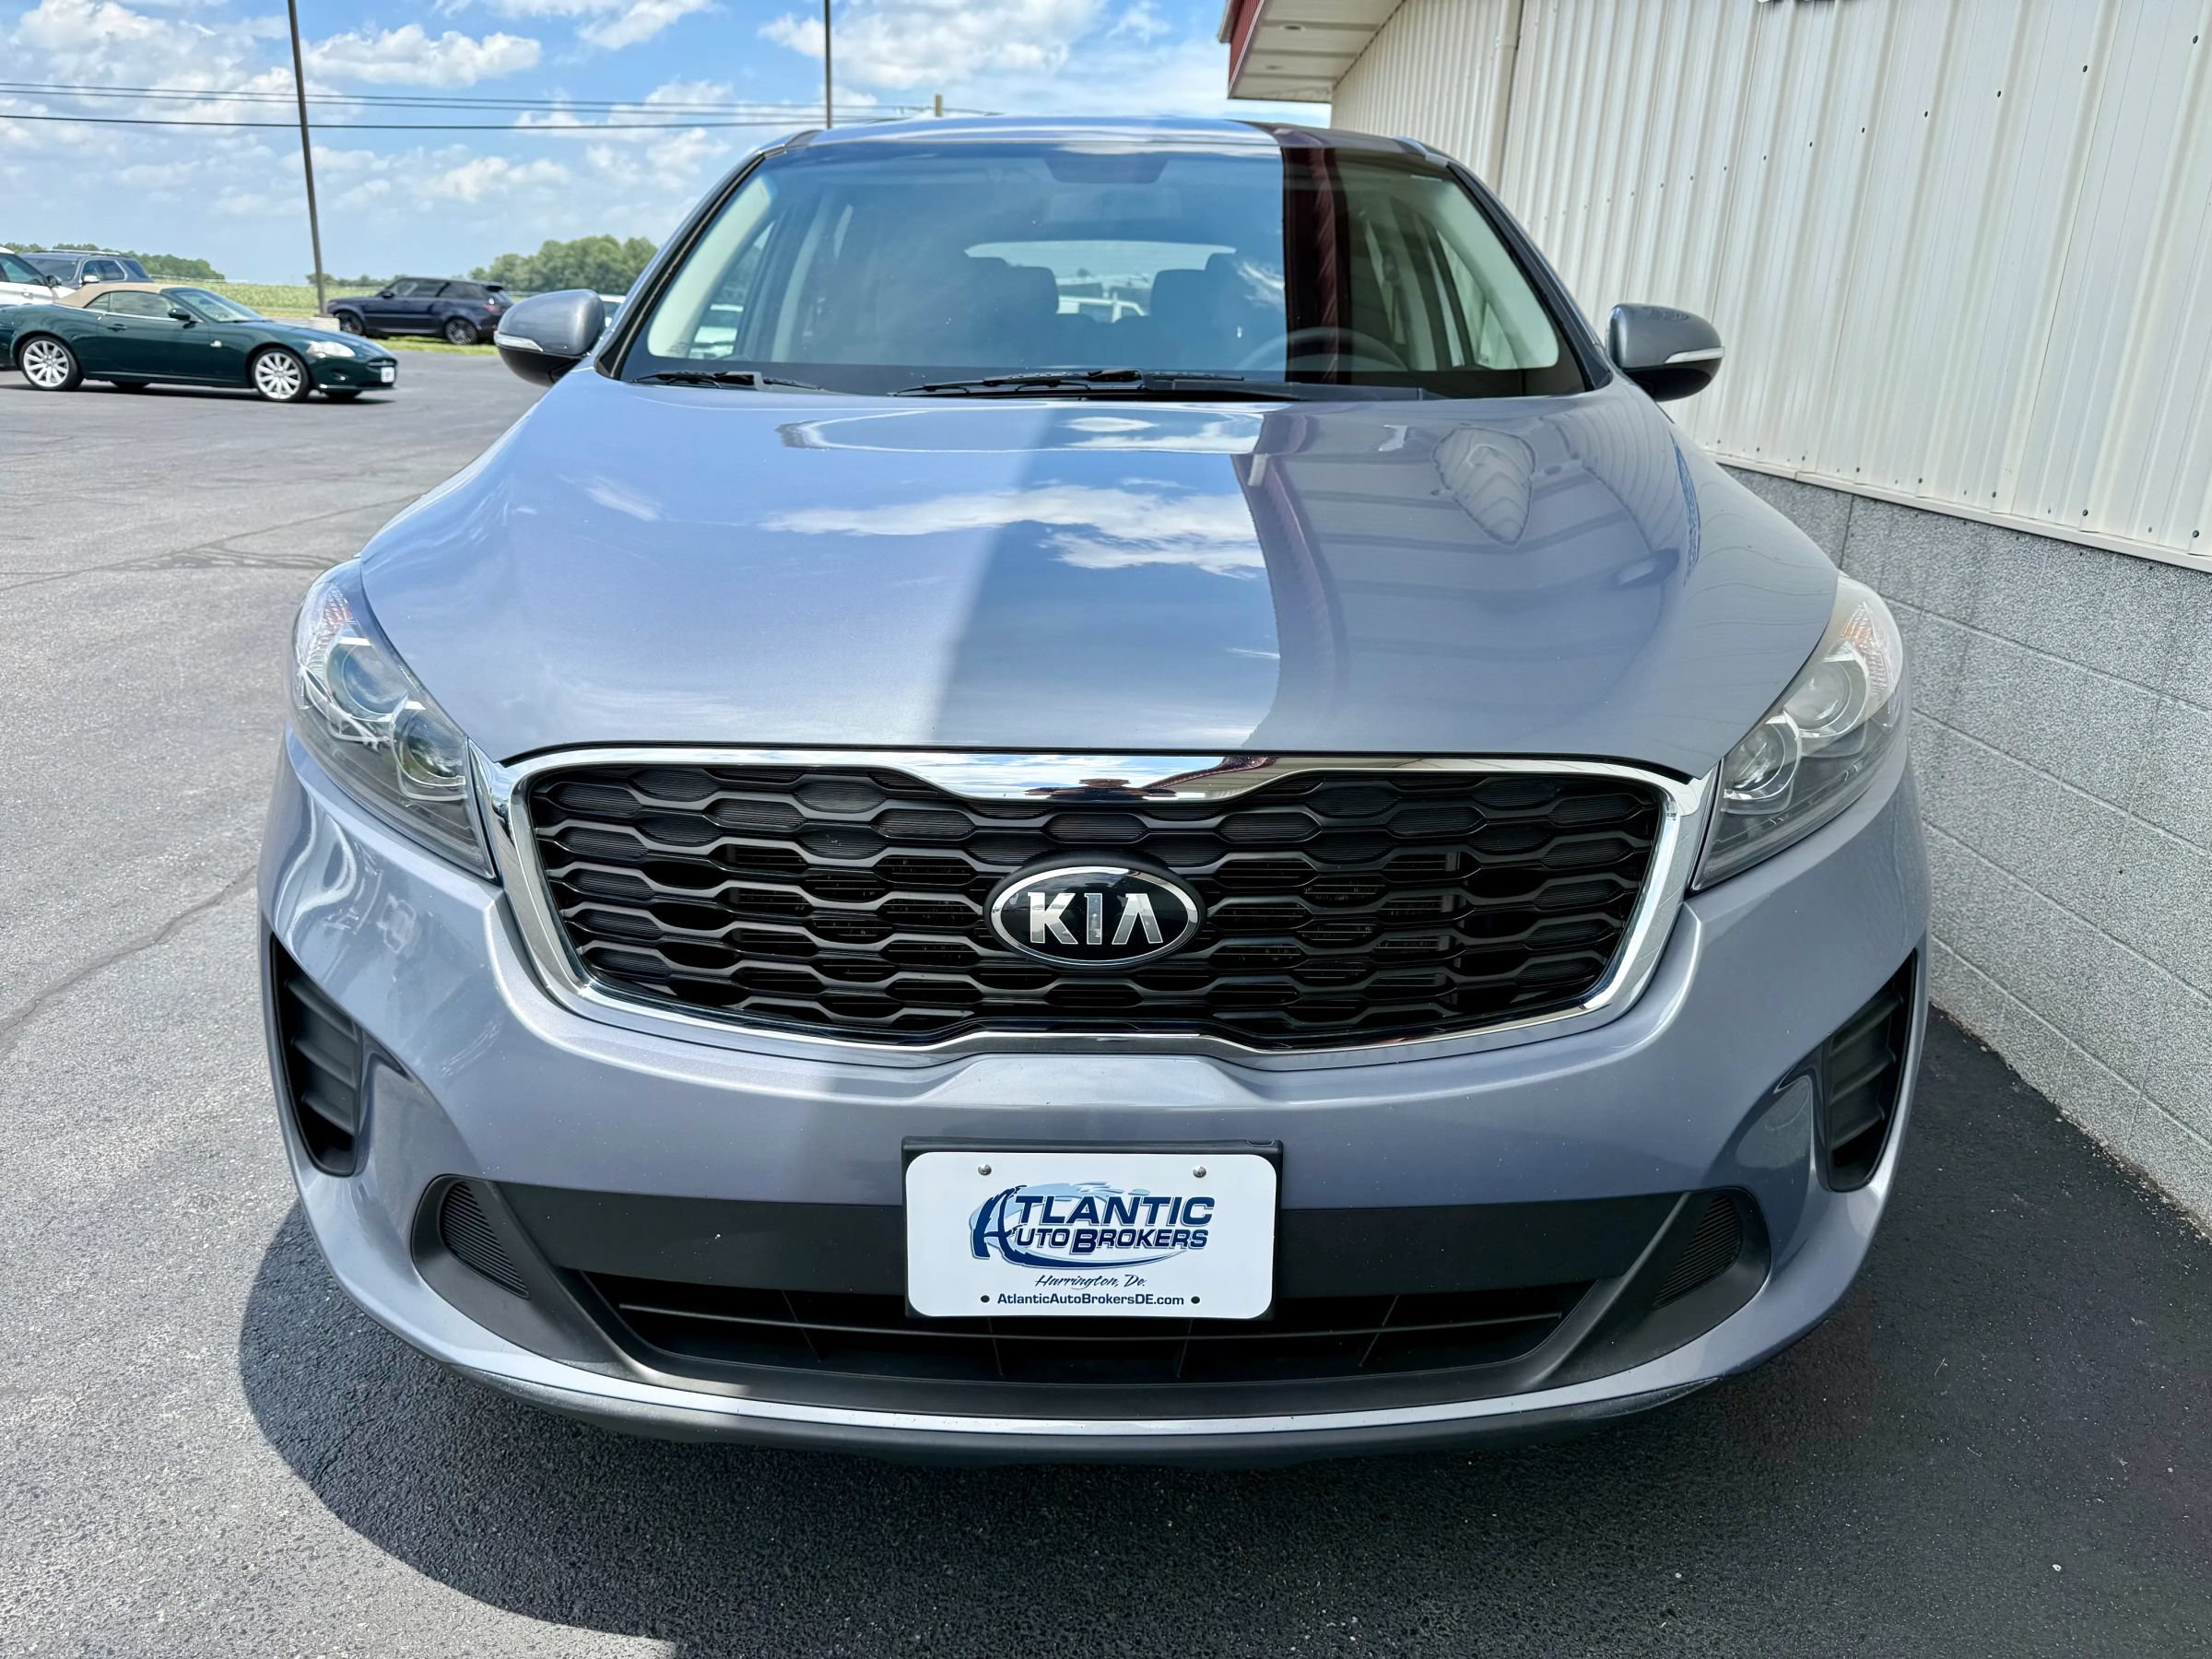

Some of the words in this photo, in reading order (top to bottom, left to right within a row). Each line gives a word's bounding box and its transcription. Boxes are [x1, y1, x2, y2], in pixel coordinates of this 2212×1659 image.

[1028, 891, 1164, 945] KIA
[973, 1185, 1216, 1259] ATLANTIC
[997, 1293, 1184, 1305] AtlanticAutoBrokersDE.com
[1034, 1275, 1120, 1290] Harrington,
